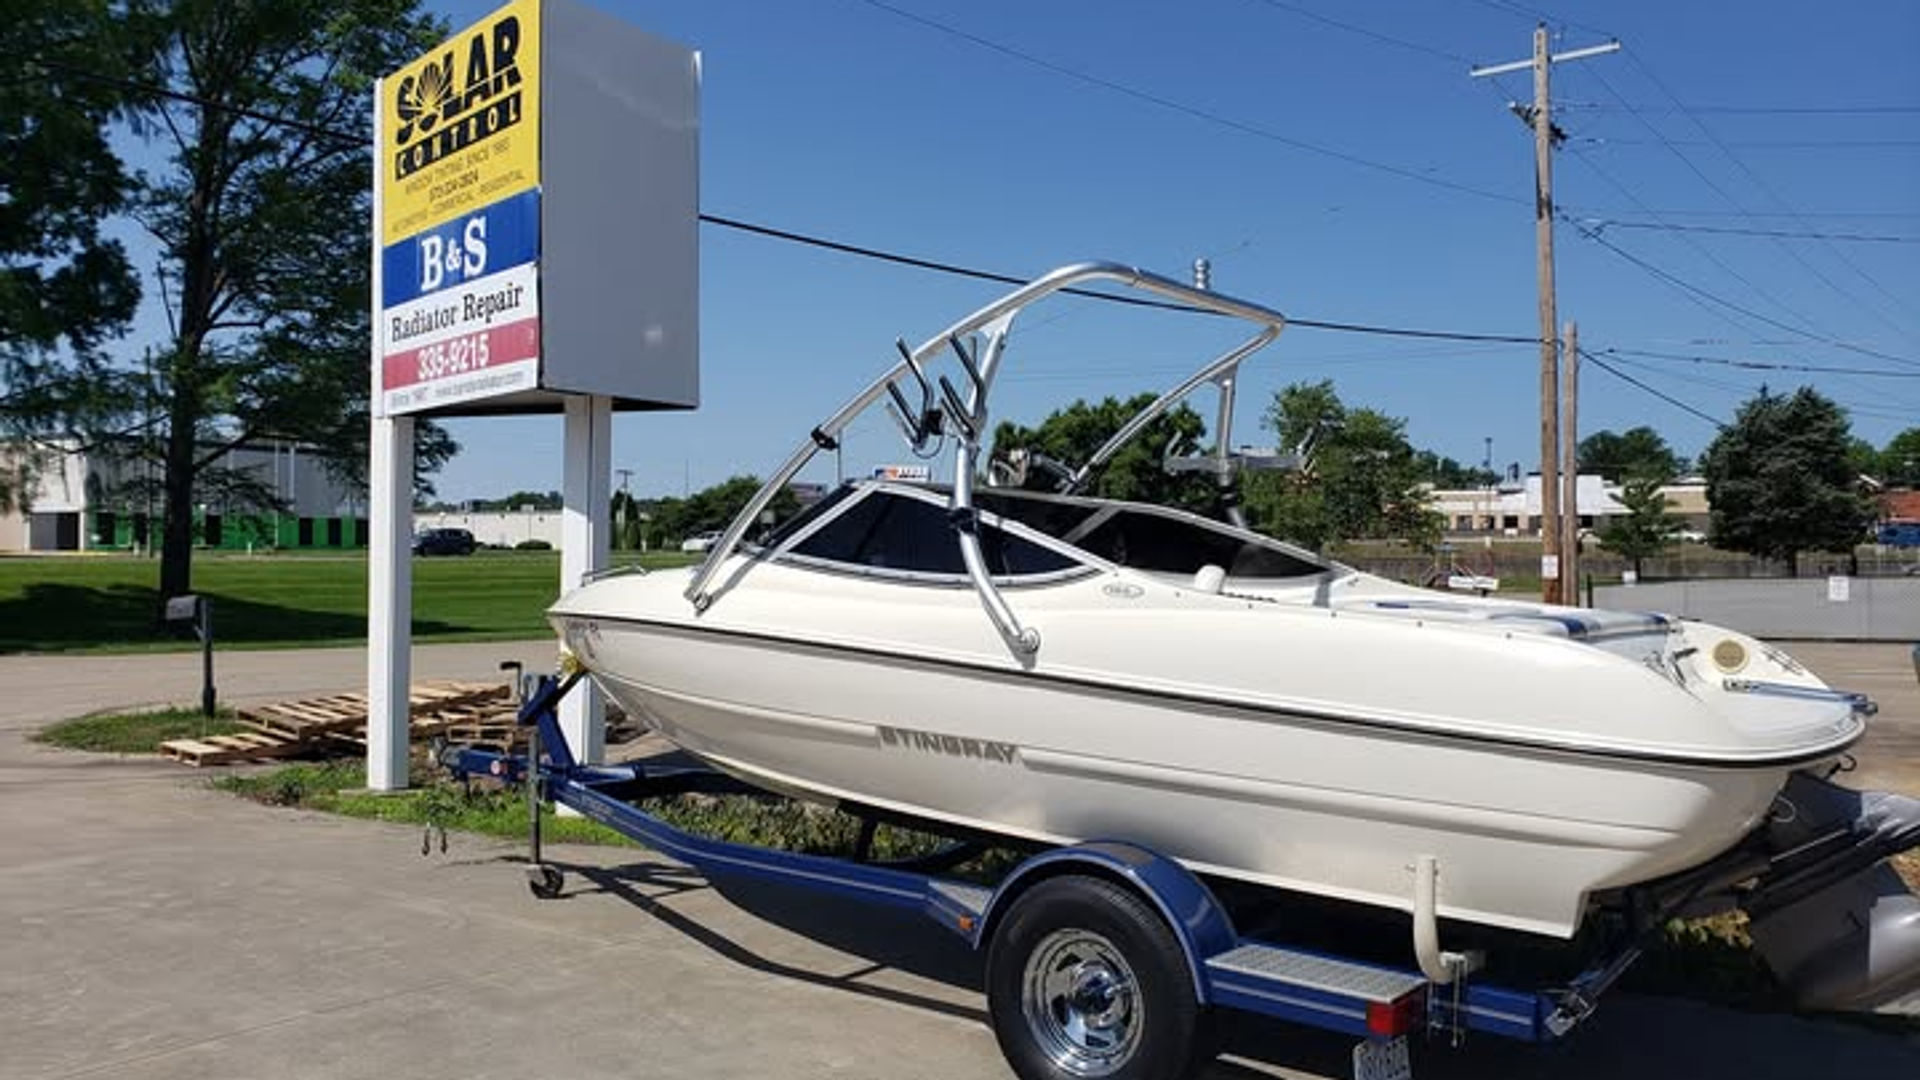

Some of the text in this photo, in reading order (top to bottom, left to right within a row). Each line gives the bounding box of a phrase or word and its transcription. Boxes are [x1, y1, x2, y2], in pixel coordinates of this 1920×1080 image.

[397, 16, 522, 145] SOLAR
[397, 92, 520, 180] CONTROL
[421, 216, 487, 292] B&S
[392, 282, 524, 343] Radiator Repair
[417, 333, 489, 381] 335-9215
[880, 725, 1018, 765] STINGRAY
